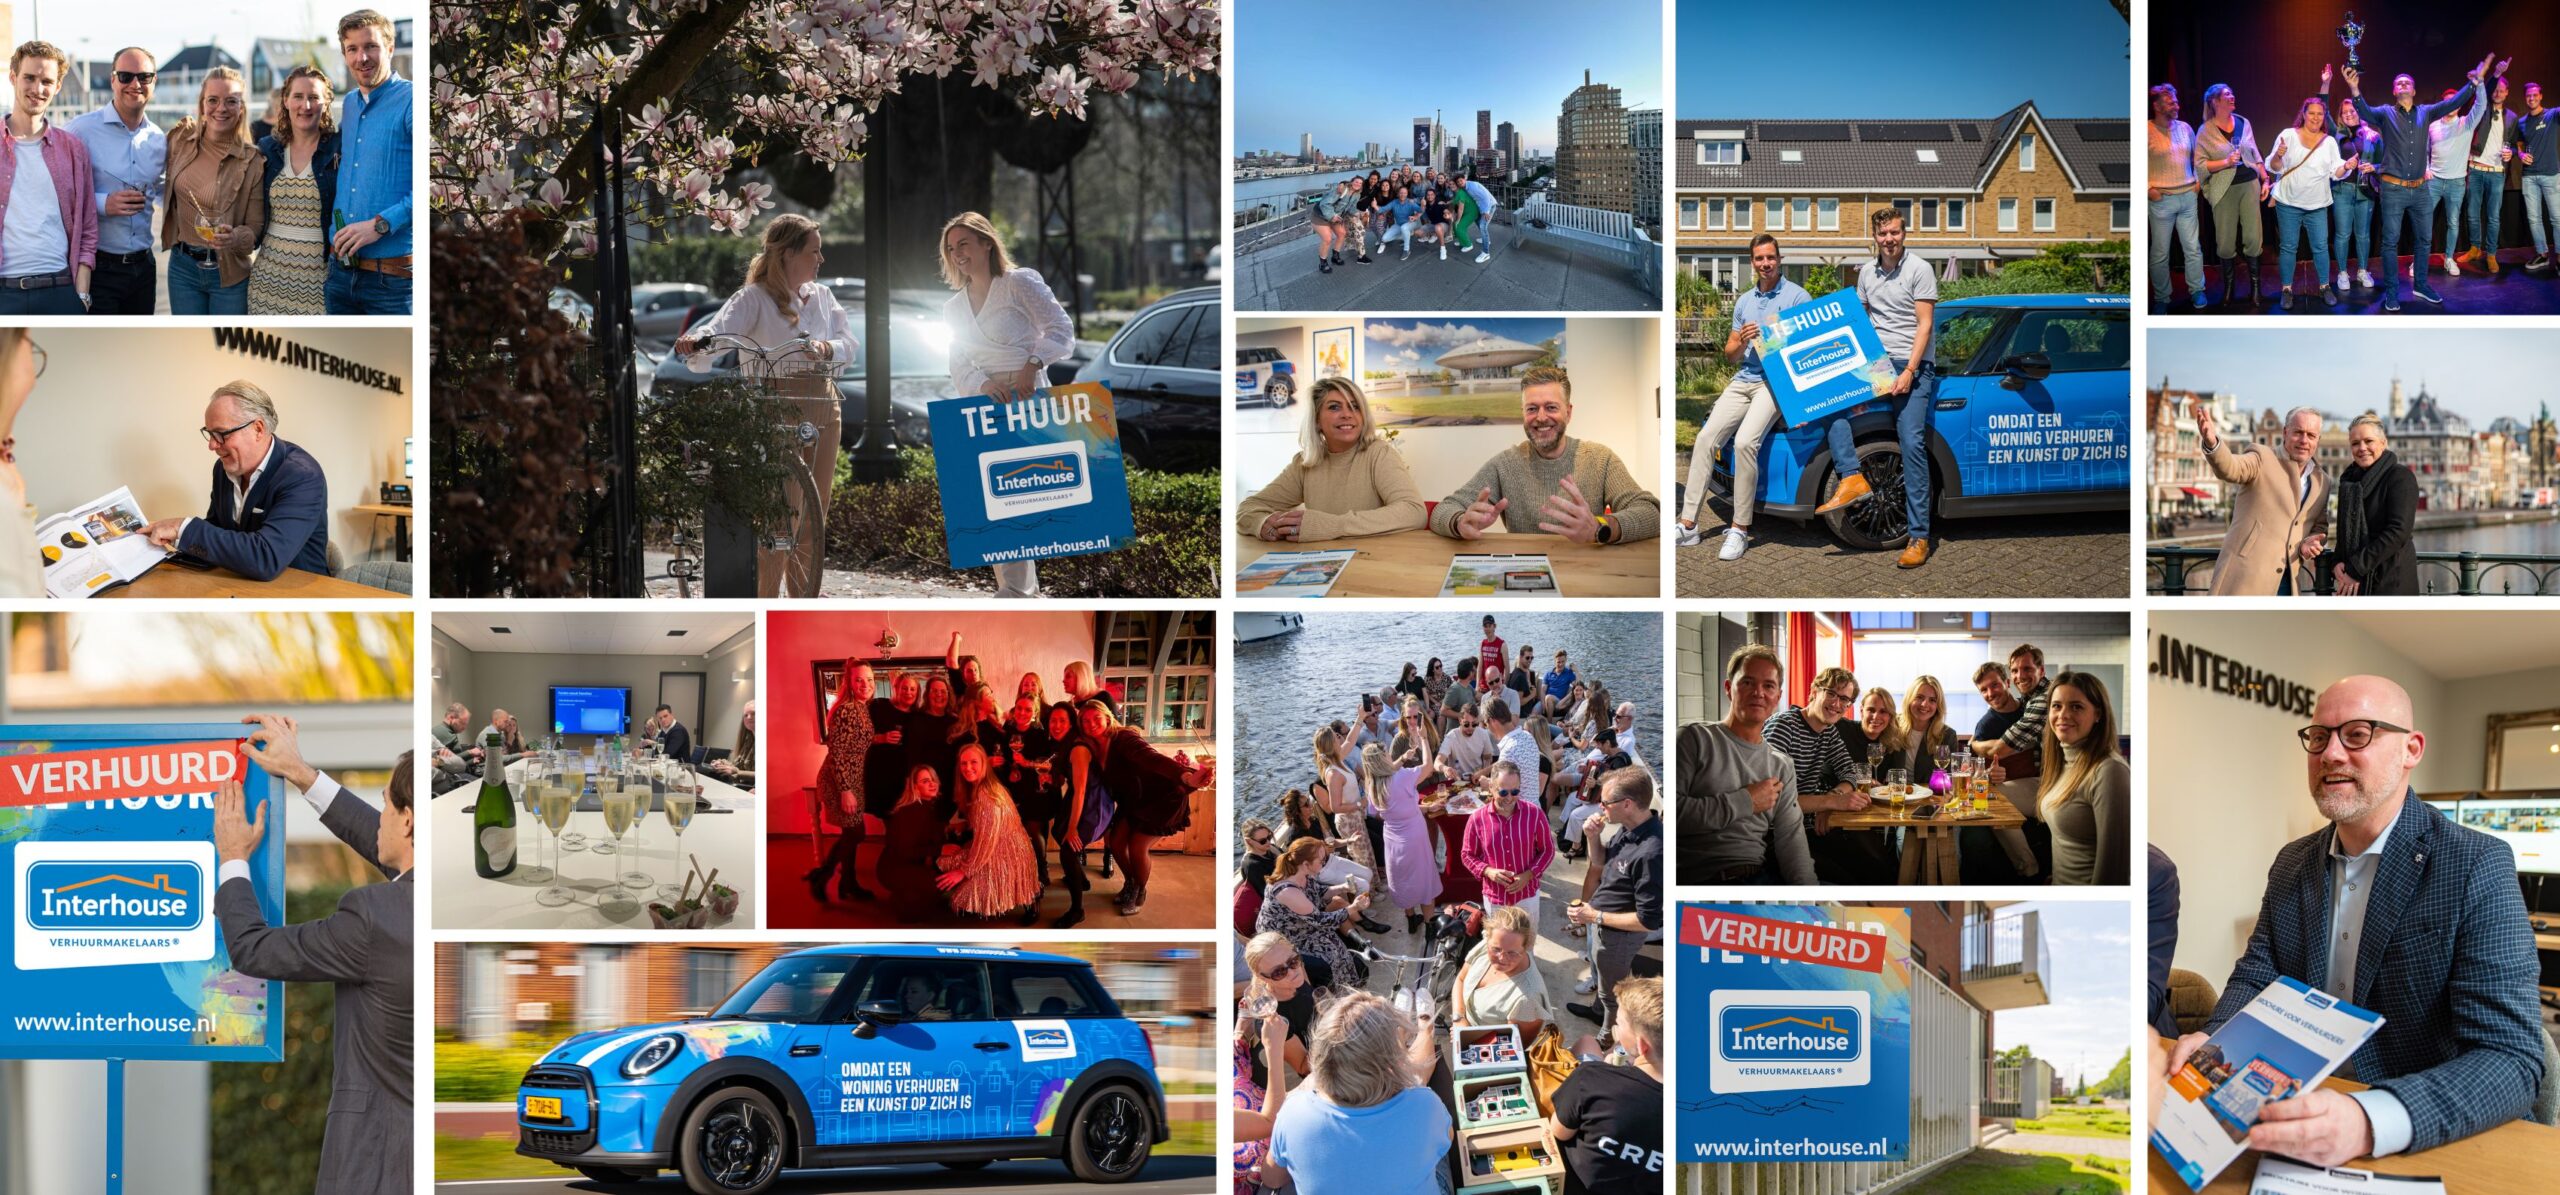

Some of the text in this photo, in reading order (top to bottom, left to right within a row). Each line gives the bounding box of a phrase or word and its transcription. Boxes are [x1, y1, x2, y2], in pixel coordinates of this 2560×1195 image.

[1769, 302, 1844, 338] TE HUUR
[213, 327, 404, 395] WWW.INTERHOUSE.NL
[1795, 347, 1851, 371] Interhouse
[961, 393, 1093, 437] TE HUUR
[1988, 413, 2062, 429] OMDAT EEN
[1989, 429, 2113, 446] WONING VERHUREN
[1988, 445, 2127, 464] EEN KUNST OP ZICH IS
[996, 471, 1075, 492] Interhouse
[1004, 494, 1068, 507] VERHUURMAKELAARS
[982, 535, 1110, 563] www.interhouse.nl
[2148, 627, 2315, 719] .INTERHOUSE
[11, 750, 237, 796] VERHUURD
[41, 888, 188, 917] Interhouse
[49, 937, 171, 948] VERHUURMAKELAARS
[1697, 914, 1871, 963] VERHUURD
[14, 1011, 217, 1033] www.interhouse.nl
[1028, 1036, 1067, 1045] Interhouse
[1731, 1027, 1849, 1052] Interhouse
[841, 1062, 911, 1077] OMDAT EEN
[1739, 1067, 1835, 1077] VERHUURMAKELAARS
[842, 1079, 959, 1095] WONING VERHUREN
[841, 1095, 972, 1112] EEN KUNST OP ZICH IS
[1694, 1137, 1887, 1157] www.interhouse.nl
